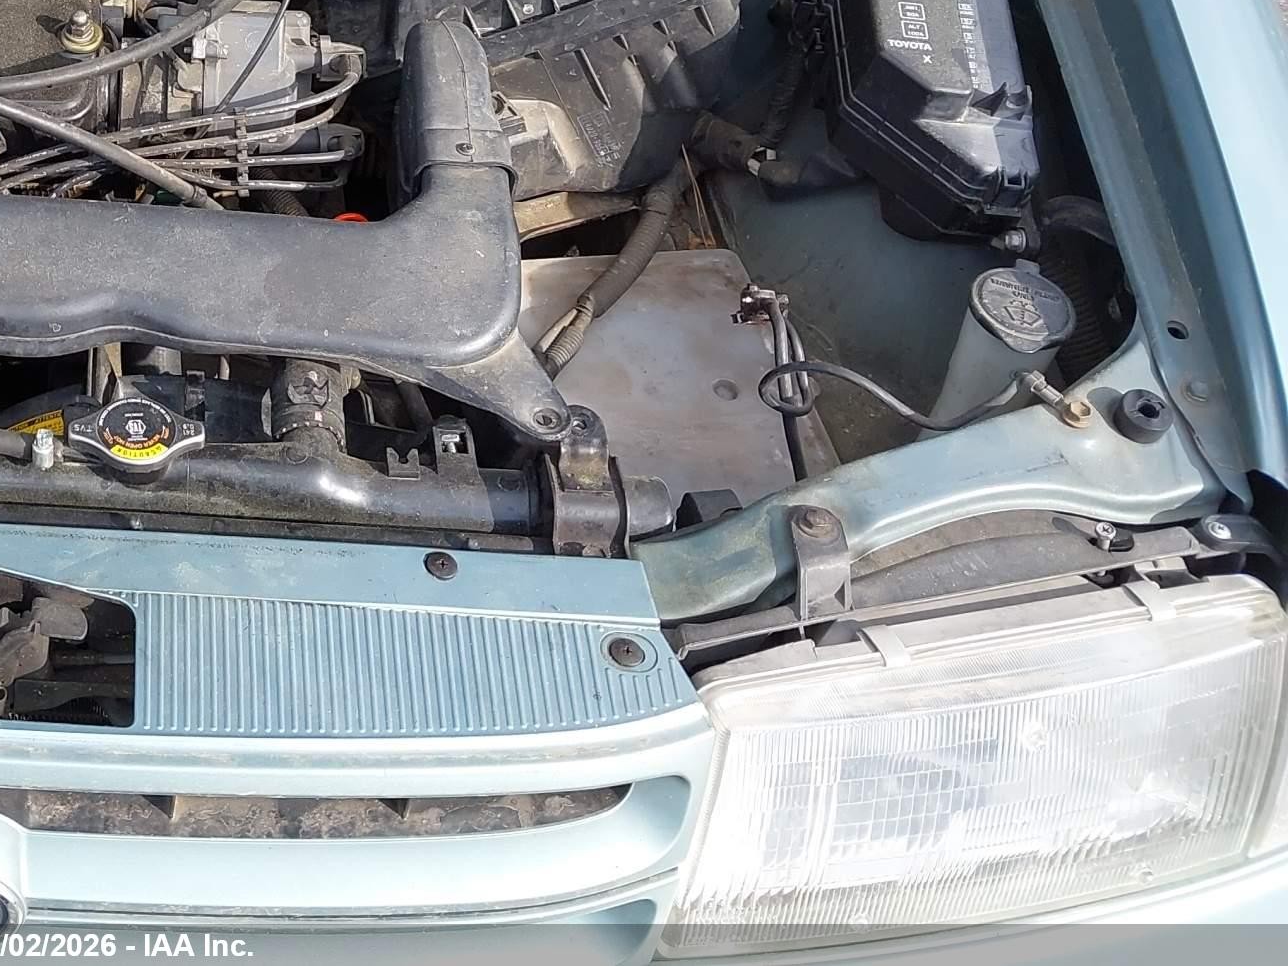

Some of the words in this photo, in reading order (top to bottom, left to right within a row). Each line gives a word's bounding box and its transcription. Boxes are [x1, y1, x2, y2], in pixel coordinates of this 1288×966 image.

[887, 38, 932, 51] TOYOTA
[922, 54, 933, 64] X
[73, 423, 93, 432] TVS
